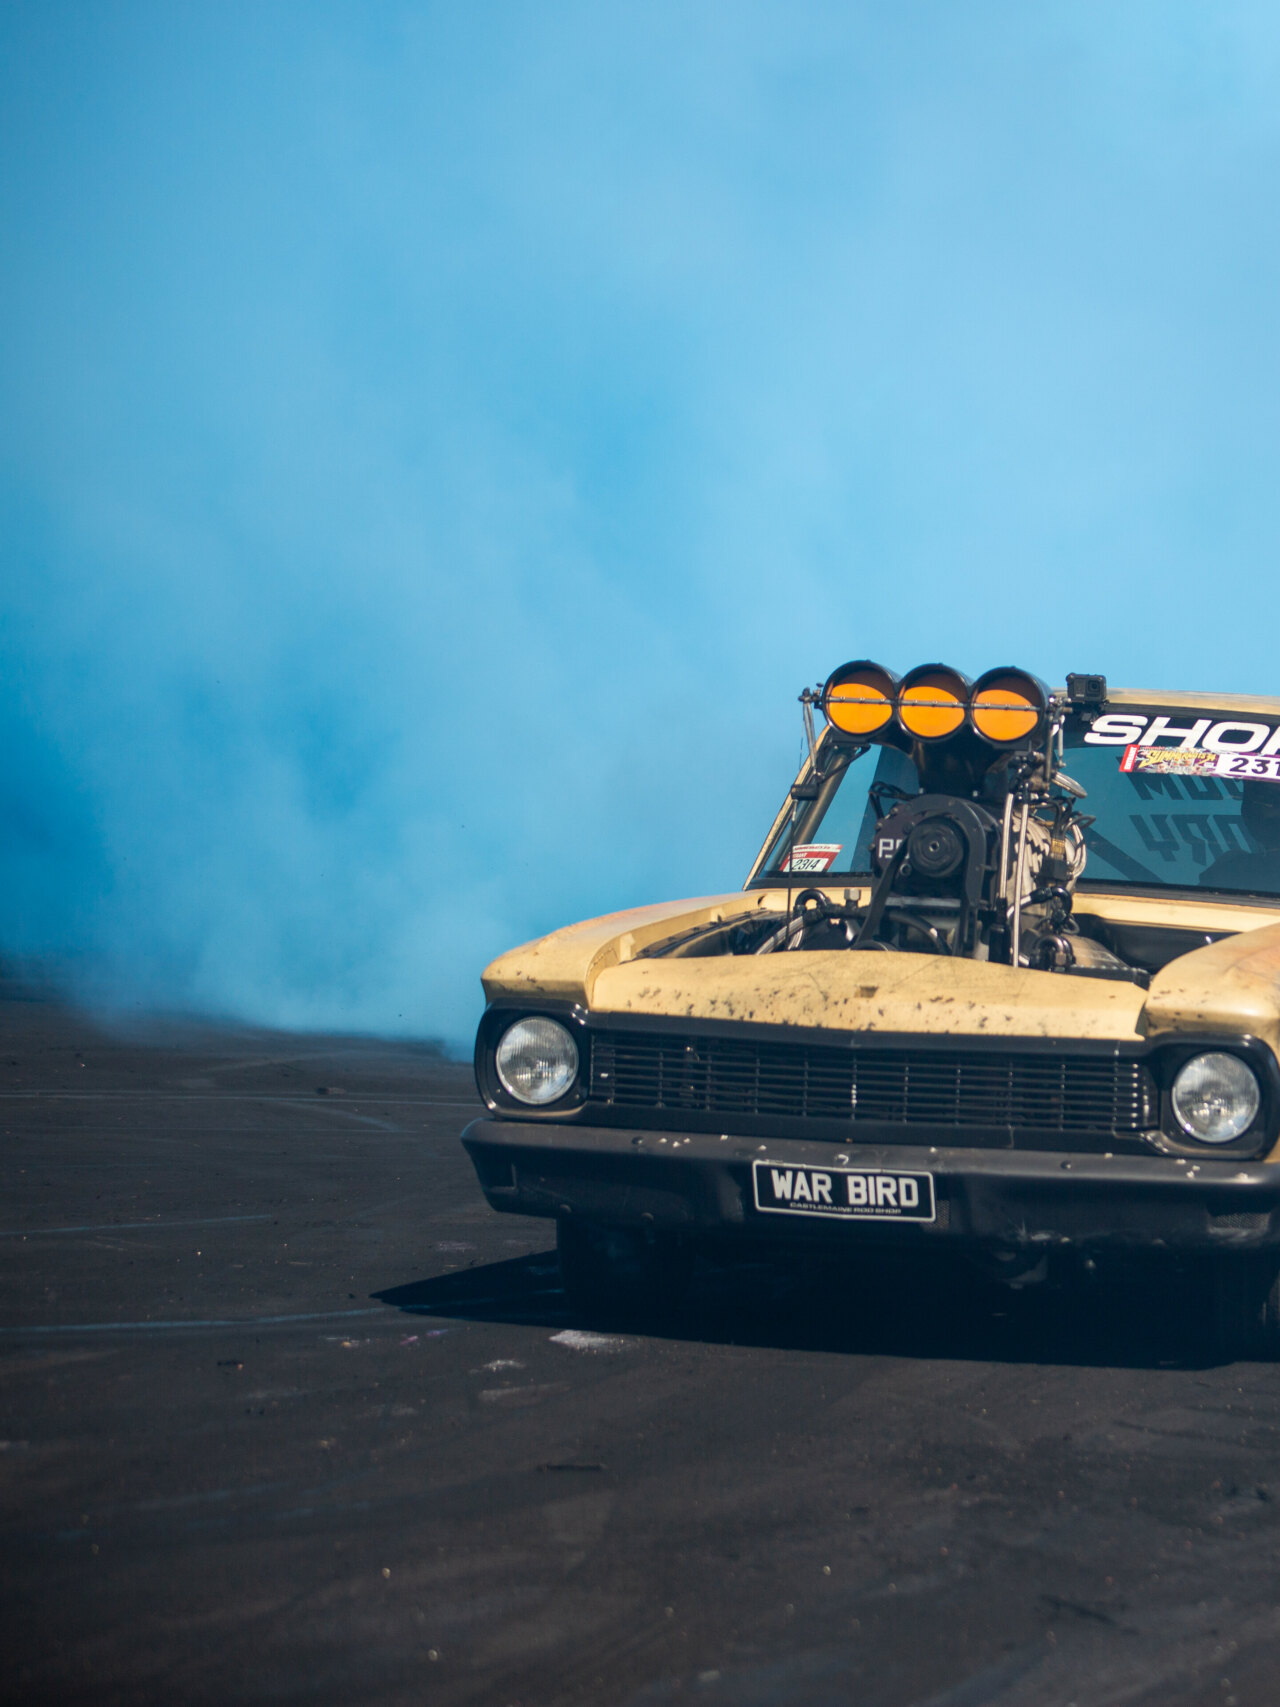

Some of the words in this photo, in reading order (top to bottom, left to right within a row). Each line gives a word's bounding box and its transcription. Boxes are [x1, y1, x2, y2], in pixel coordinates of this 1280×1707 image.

[791, 859, 820, 870] 2314
[771, 1169, 833, 1203] WAR
[847, 1175, 919, 1207] BIRD
